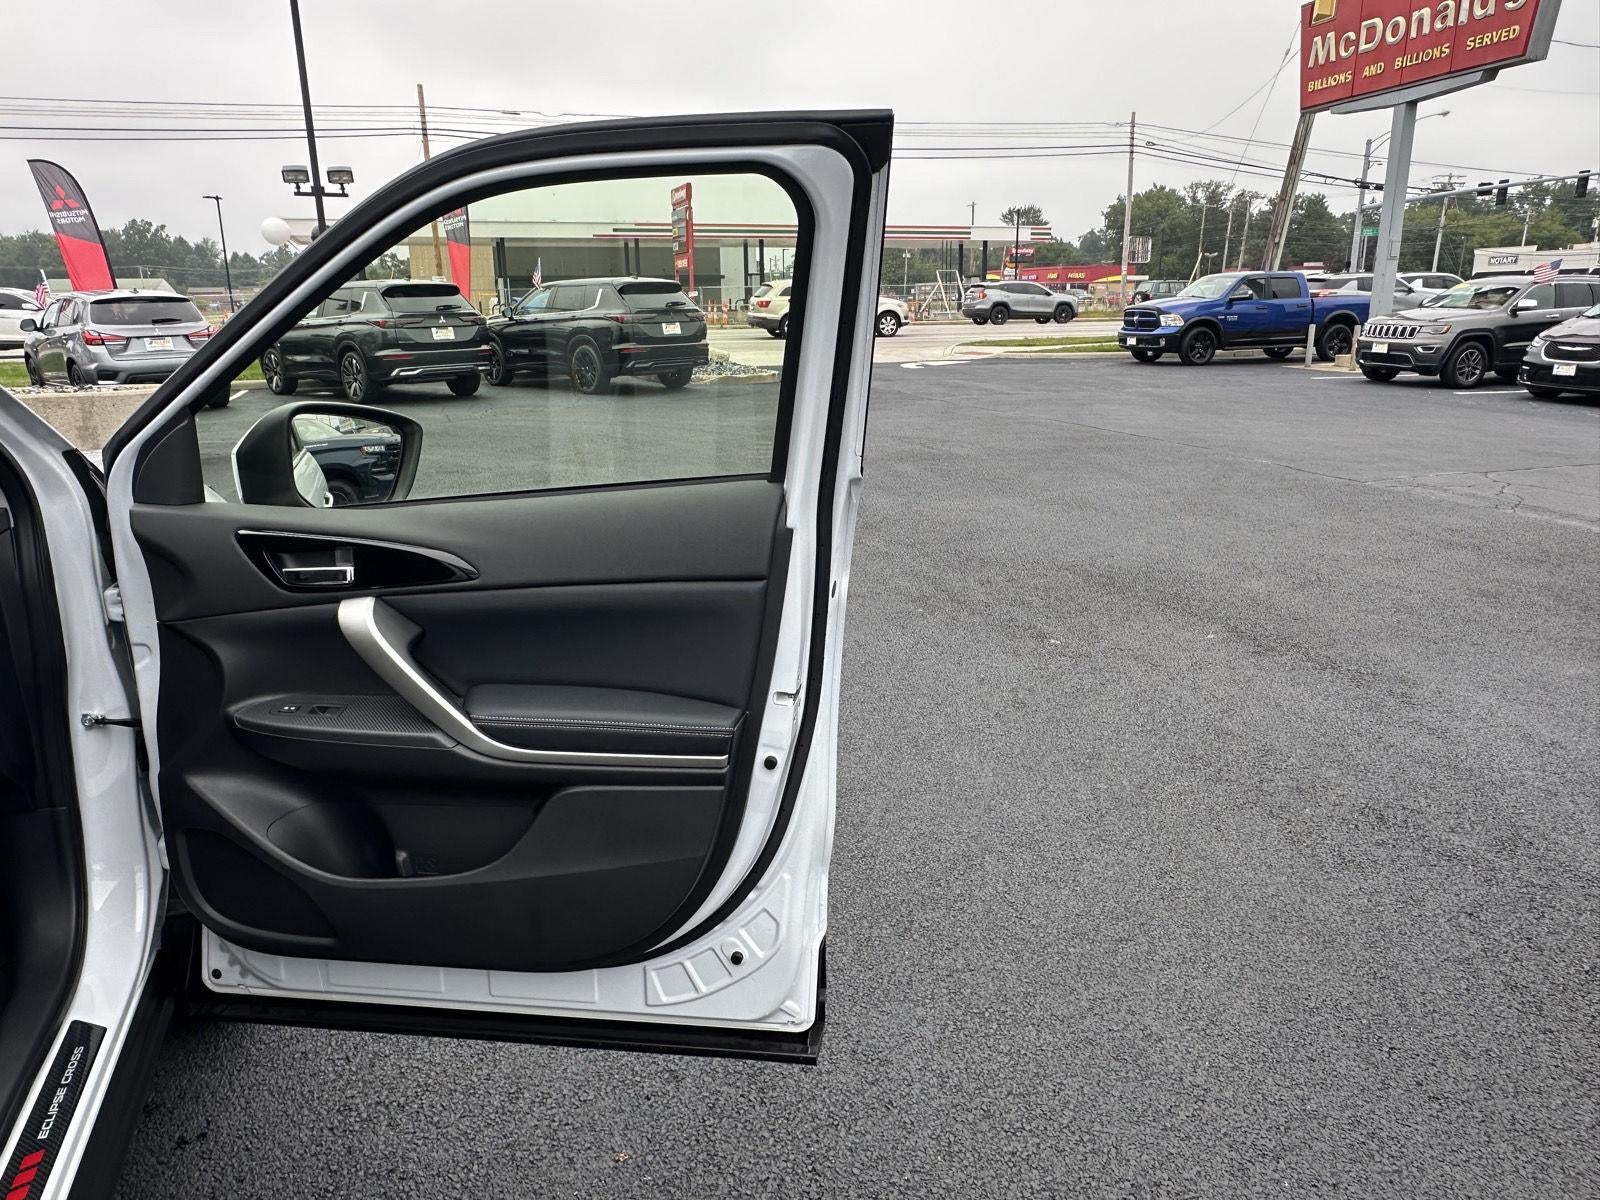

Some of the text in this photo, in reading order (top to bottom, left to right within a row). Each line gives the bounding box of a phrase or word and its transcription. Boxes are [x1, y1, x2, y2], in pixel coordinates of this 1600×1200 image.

[1307, 24, 1520, 92] BILLIONS AND BILLIONS SERVED
[1490, 256, 1516, 264] NOTARY
[37, 1046, 84, 1140] ECLIPSE CROSS
